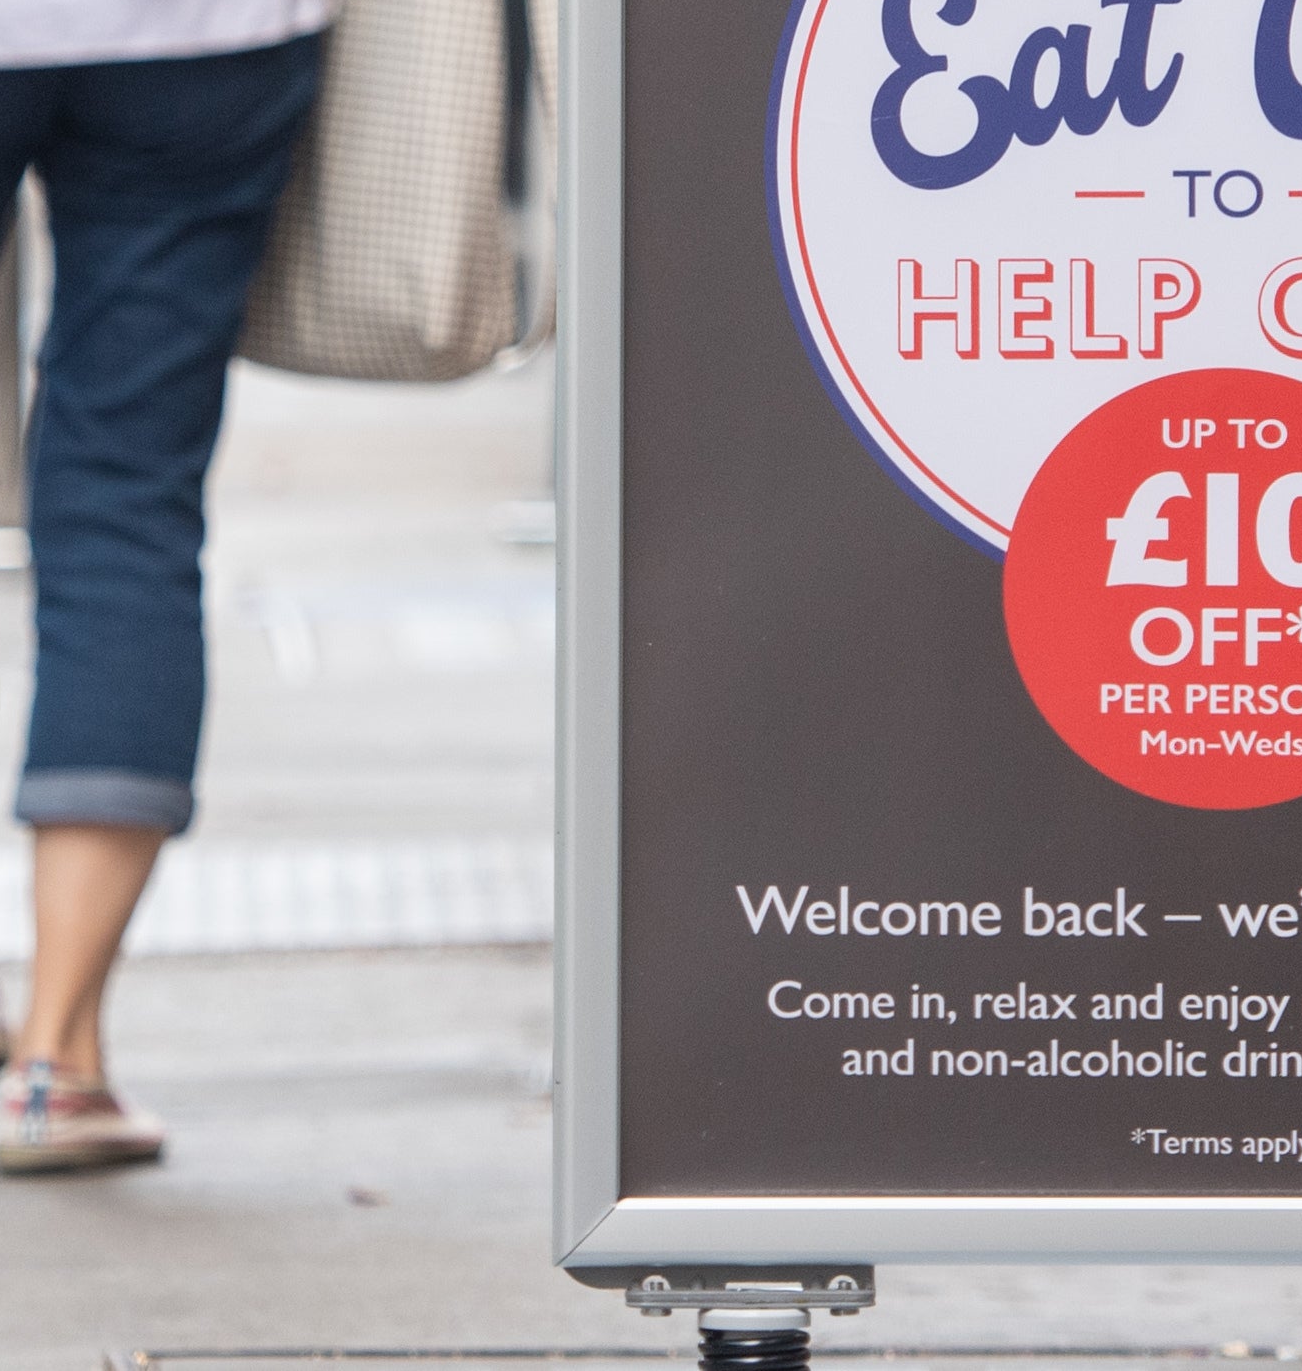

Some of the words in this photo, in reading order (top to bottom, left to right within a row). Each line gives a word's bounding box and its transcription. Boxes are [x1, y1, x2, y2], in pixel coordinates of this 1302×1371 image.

[1173, 170, 1265, 218] TO
[897, 258, 1203, 362] HELP
[1162, 419, 1218, 450] UP
[1228, 419, 1289, 451] TO
[1100, 684, 1173, 715] PER
[736, 885, 1002, 938] Welcome
[1025, 887, 1148, 938] back
[768, 980, 895, 1021] Come
[912, 983, 957, 1026] in,
[975, 982, 1078, 1022] relax
[1092, 983, 1164, 1022] and
[1180, 985, 1292, 1033] enjoy
[843, 1039, 915, 1078] and
[932, 1039, 1208, 1079] non-alcoholic
